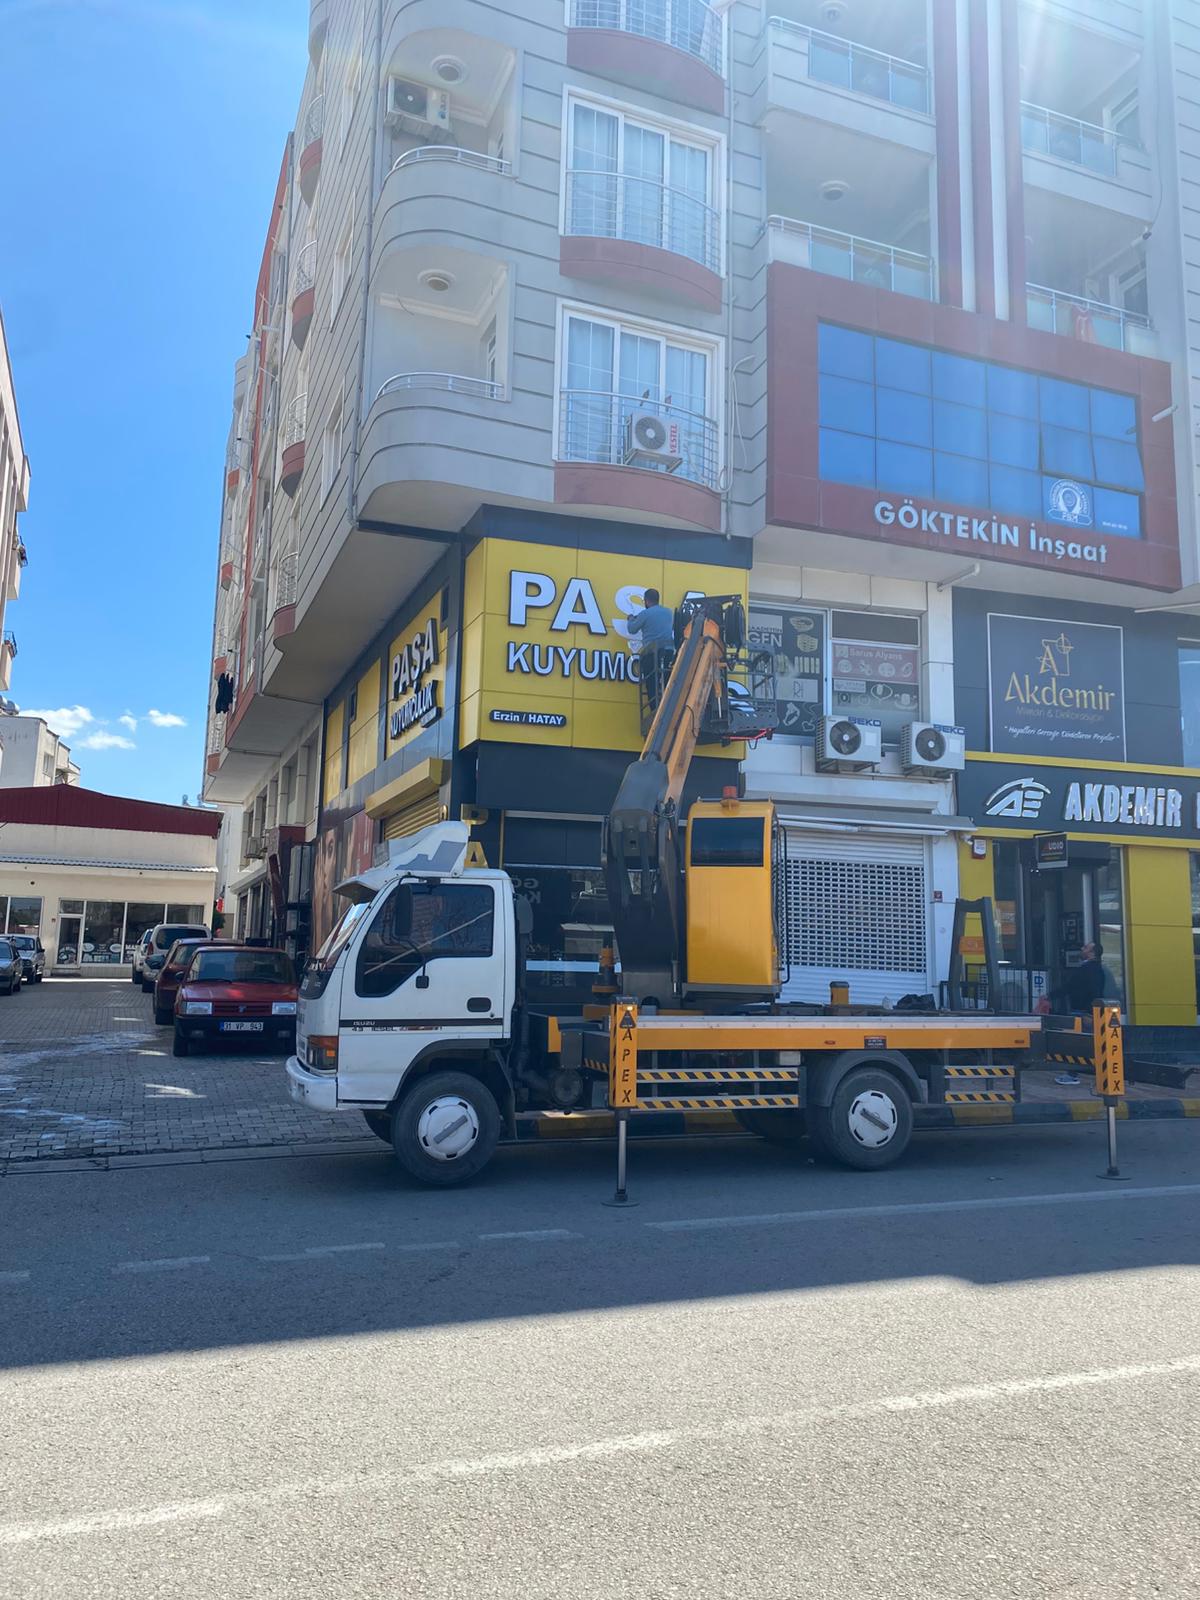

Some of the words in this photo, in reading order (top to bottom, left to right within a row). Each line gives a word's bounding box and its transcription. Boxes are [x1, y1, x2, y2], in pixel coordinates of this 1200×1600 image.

[874, 499, 1019, 547] GÖKTEKİN
[1029, 522, 1107, 563] İnşaat
[508, 569, 706, 653] PAŞ
[391, 618, 440, 702] PAŞA
[1004, 671, 1116, 711] Akdemir
[493, 711, 520, 722] Erzin
[528, 714, 563, 725] HATAY
[848, 716, 882, 727] BEKO
[621, 1027, 633, 1104] APEX
[1110, 1028, 1121, 1092] APEX
